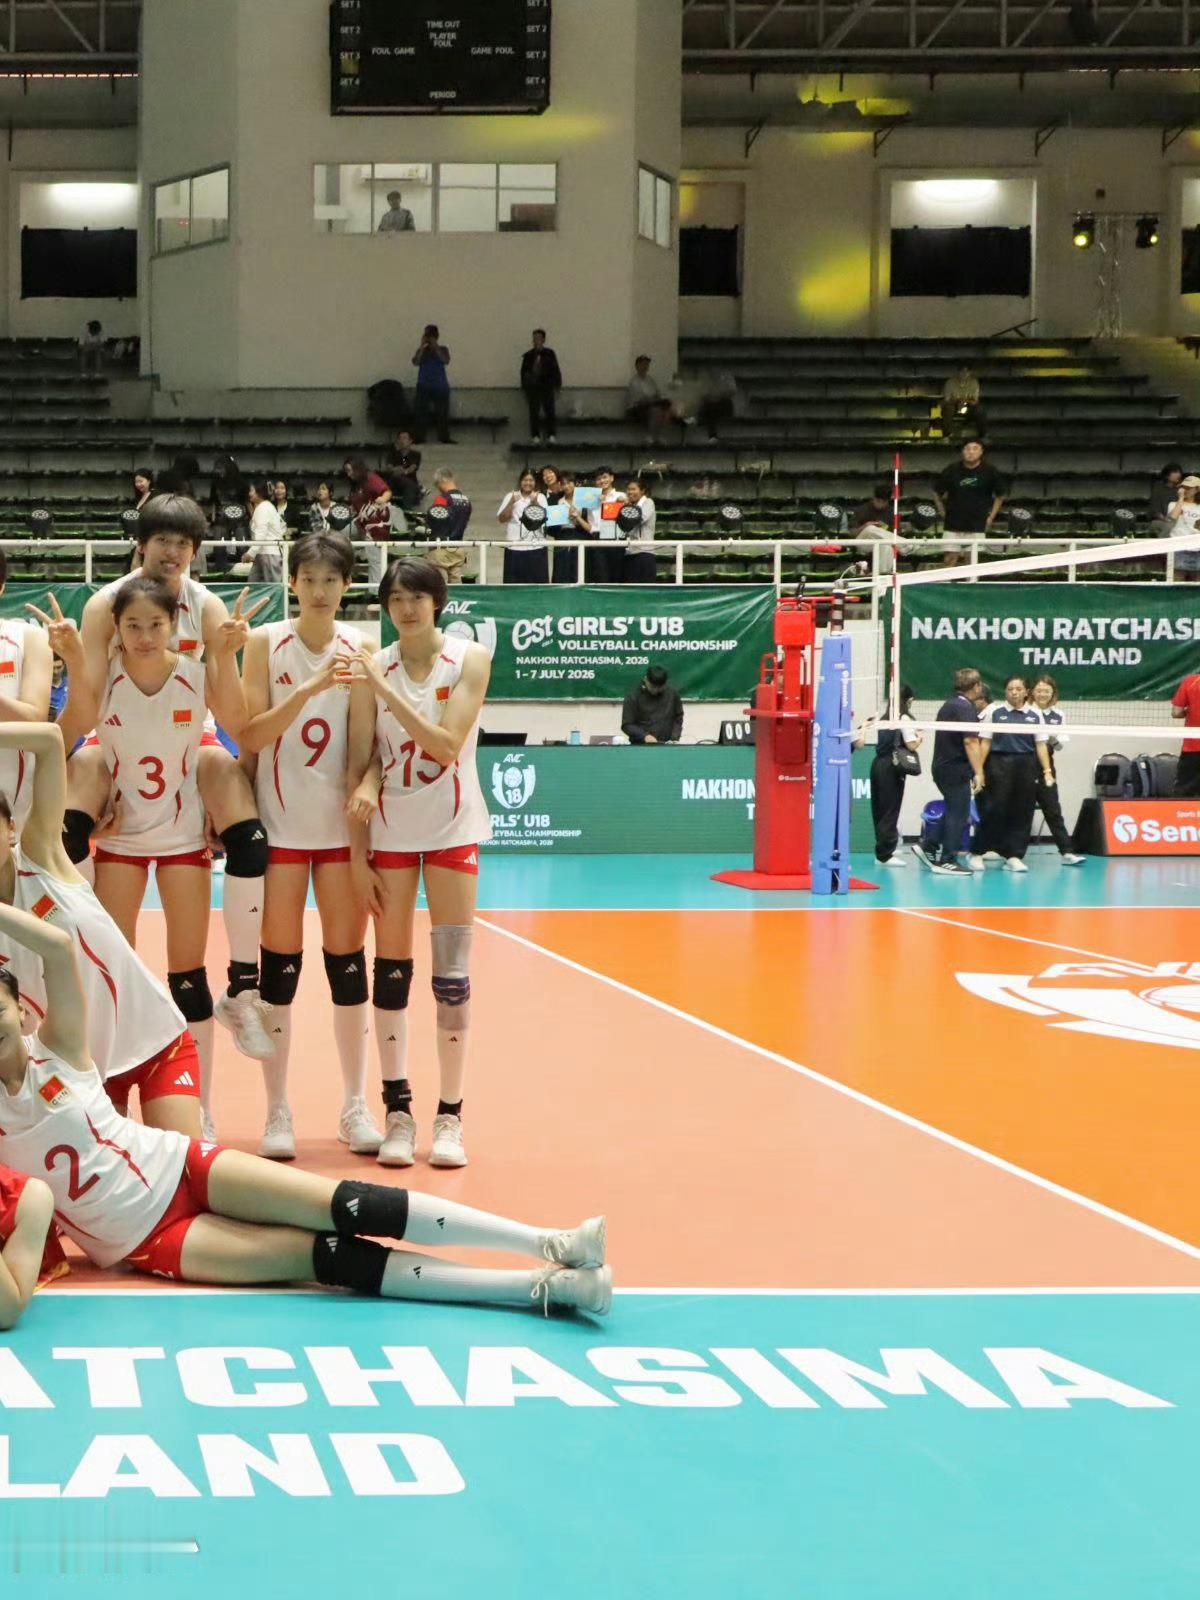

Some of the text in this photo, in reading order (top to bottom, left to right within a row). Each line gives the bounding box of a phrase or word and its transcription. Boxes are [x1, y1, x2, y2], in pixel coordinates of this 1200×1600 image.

[340, 26, 354, 34] SET
[427, 20, 460, 28] TIME OUT
[526, 25, 540, 33] SET
[430, 32, 456, 40] PLAYER
[372, 47, 415, 55] FOUL GAME
[471, 46, 492, 55] GAME
[442, 601, 477, 614] AVC
[512, 615, 554, 651] est
[640, 616, 684, 636] U18
[910, 617, 1046, 640] NAKHON
[558, 640, 738, 651] VOLLEYBALL CHAMPIONSHIP
[516, 656, 649, 666] NAKHON RATCHASIMA, 2026
[1019, 647, 1142, 665] THAILAND
[515, 669, 520, 679] 1
[530, 669, 537, 679] 7
[538, 669, 566, 679] JULY
[567, 669, 596, 679] 2026
[301, 718, 331, 766] 9
[503, 753, 525, 763] AVC
[137, 756, 166, 800] 3
[682, 779, 756, 799] NAKHON
[505, 788, 522, 804] 18
[490, 814, 551, 828] RLS' U18
[524, 829, 582, 837] CHAMPIONSHIP
[1140, 819, 1200, 843] Sen
[44, 1144, 100, 1202] 2
